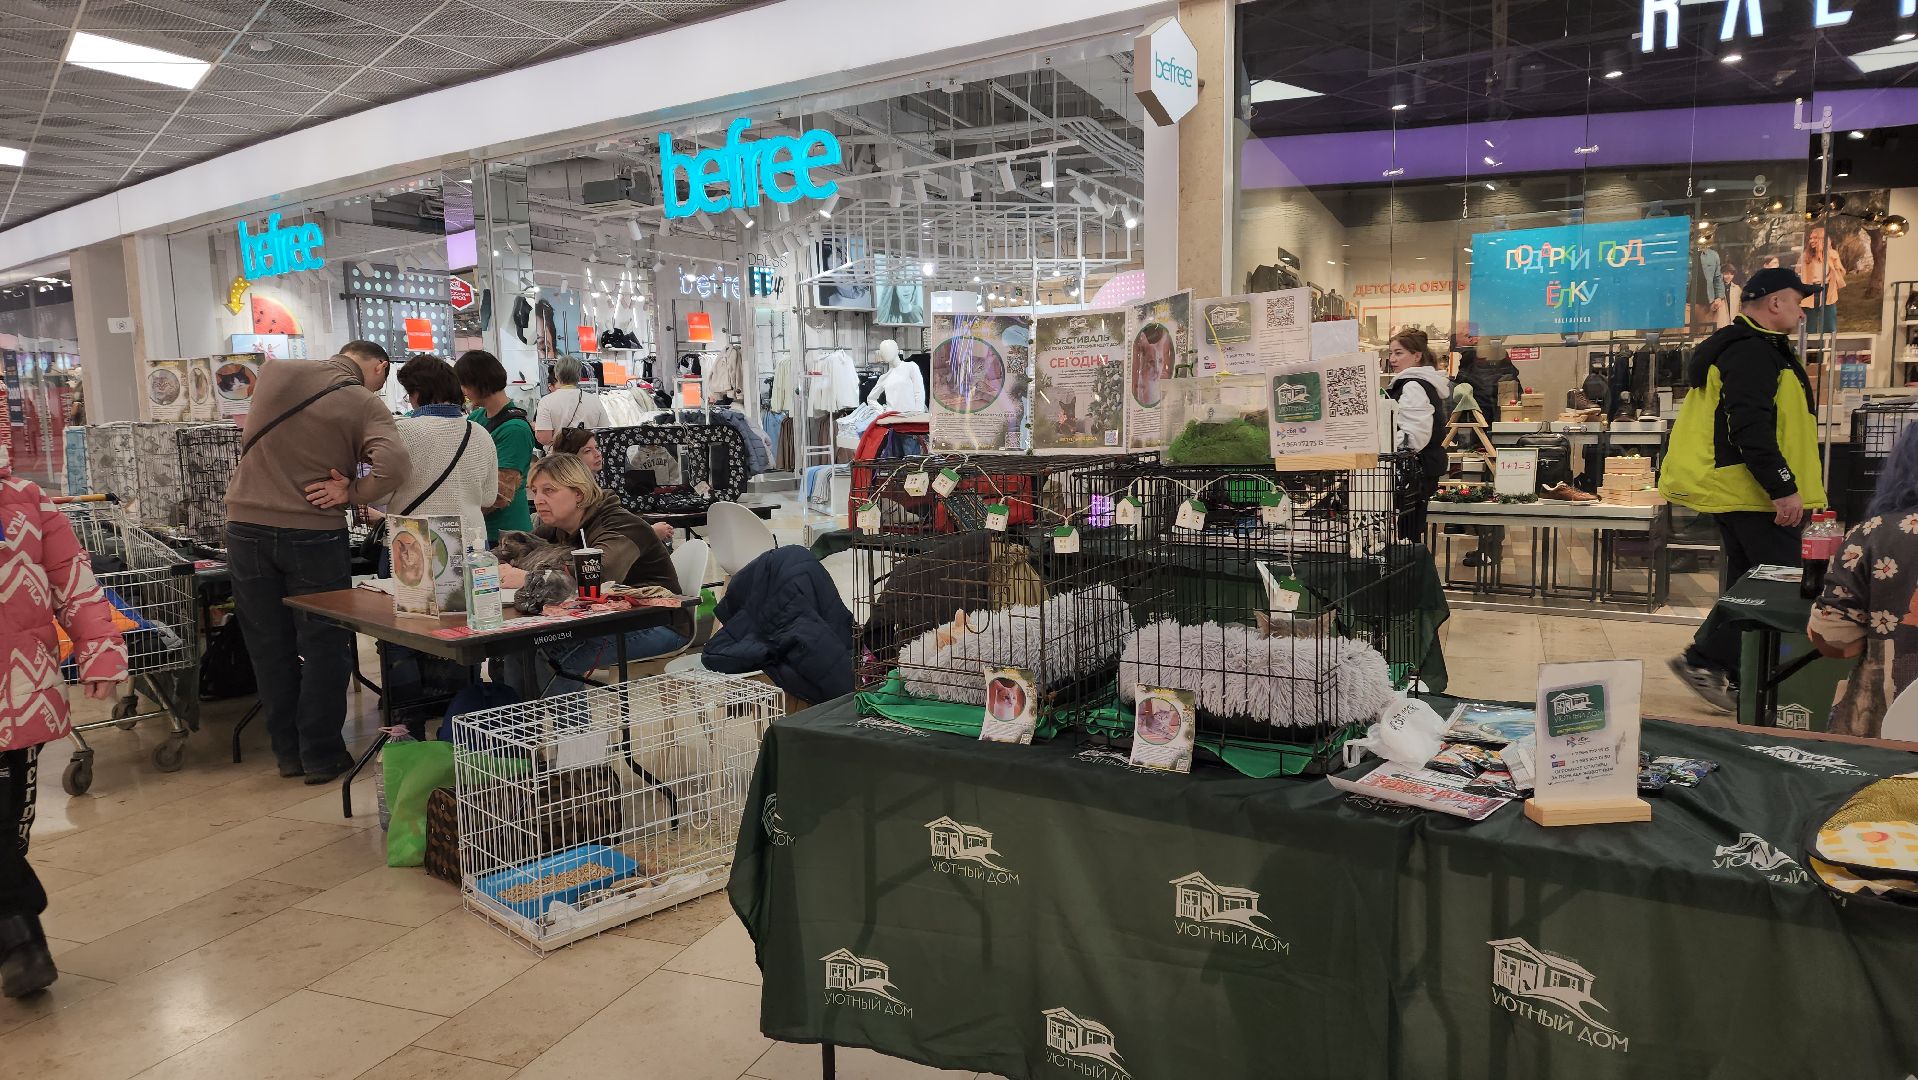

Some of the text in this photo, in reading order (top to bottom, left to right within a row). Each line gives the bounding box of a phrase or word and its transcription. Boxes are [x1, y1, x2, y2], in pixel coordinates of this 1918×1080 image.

[1155, 51, 1193, 88] befree
[658, 117, 842, 220] befree
[237, 212, 326, 281] befree
[1506, 239, 1646, 275] ПОДАРКИ ПОД
[1353, 279, 1468, 298] ДЕТСКАЯ ОБУЬ
[1546, 280, 1598, 309] ЁЛКУ
[1054, 335, 1111, 346] ФЕСТИВАЛЬ
[6, 510, 28, 535] FILA
[22, 577, 42, 607] FILA
[39, 704, 56, 735] FILA
[930, 857, 1021, 886] УЮТНЫЙ ДОМ
[1173, 919, 1290, 956] УЮТНЫЙ ДОМ
[823, 991, 913, 1020] УЮТНЫЙ ДОМ
[1492, 987, 1629, 1053] УЮТНЫЙ ДОМ
